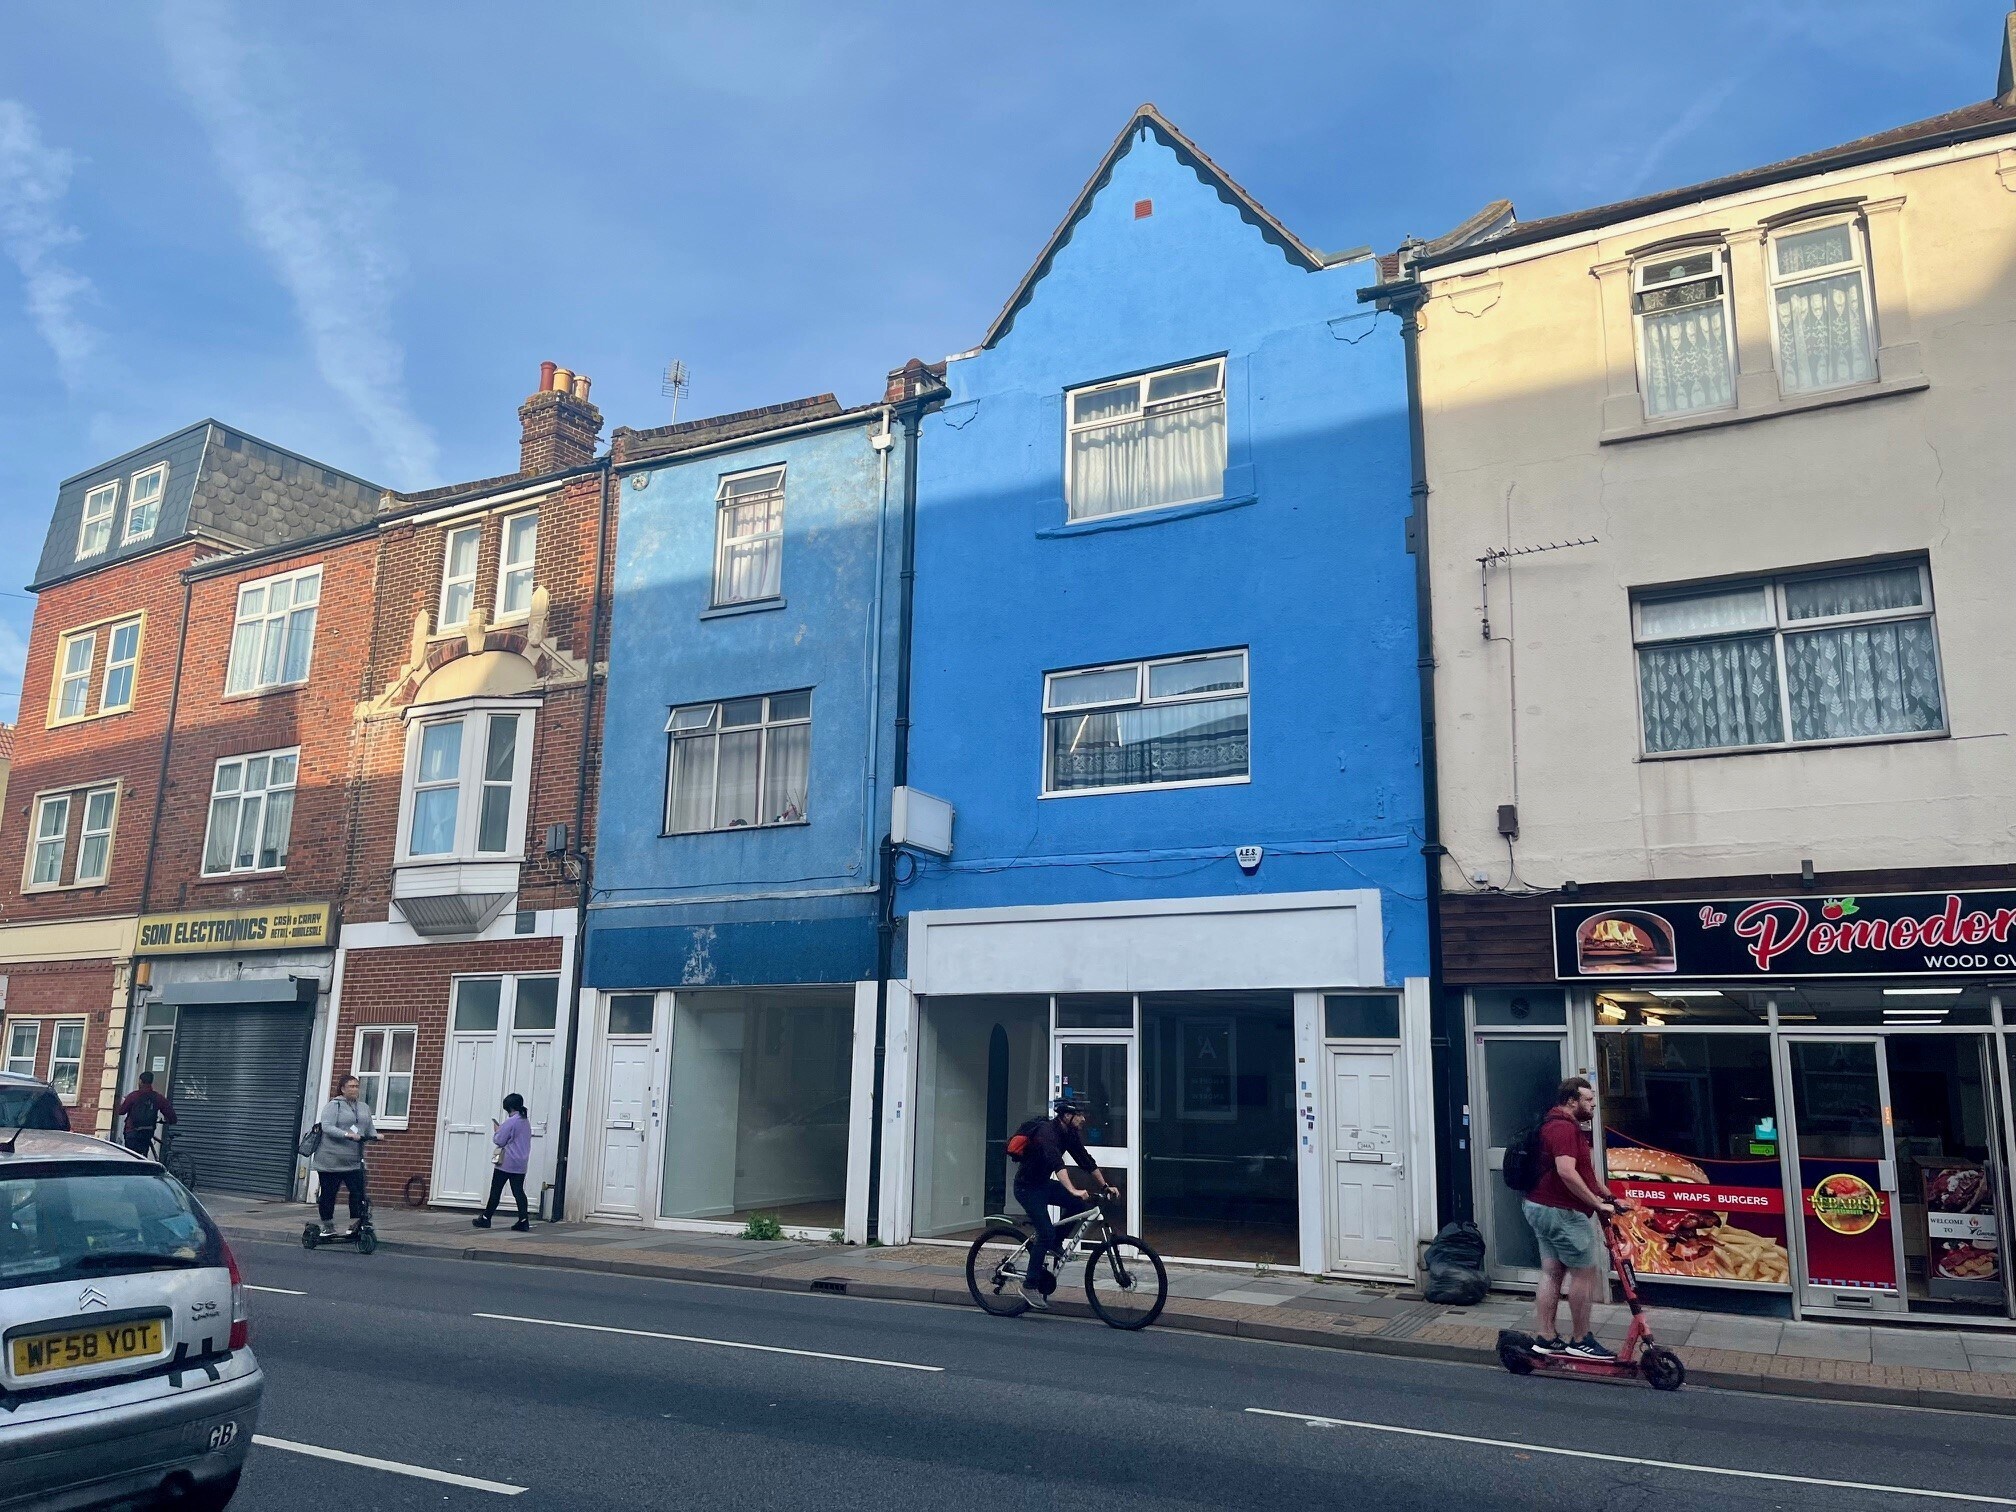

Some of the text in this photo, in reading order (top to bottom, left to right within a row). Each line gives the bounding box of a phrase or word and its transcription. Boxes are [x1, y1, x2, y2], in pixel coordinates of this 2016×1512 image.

[141, 917, 268, 946] SONI ELECTRONICS
[273, 915, 292, 926] CASH
[298, 913, 321, 925] CARRY
[1699, 895, 2016, 971] La Pomodor
[1924, 954, 1988, 968] WOOD
[1625, 1189, 1769, 1206] KEBABS WRAPS BURGERS
[26, 1326, 151, 1368] WF58 YOT
[209, 1422, 234, 1449] GB
